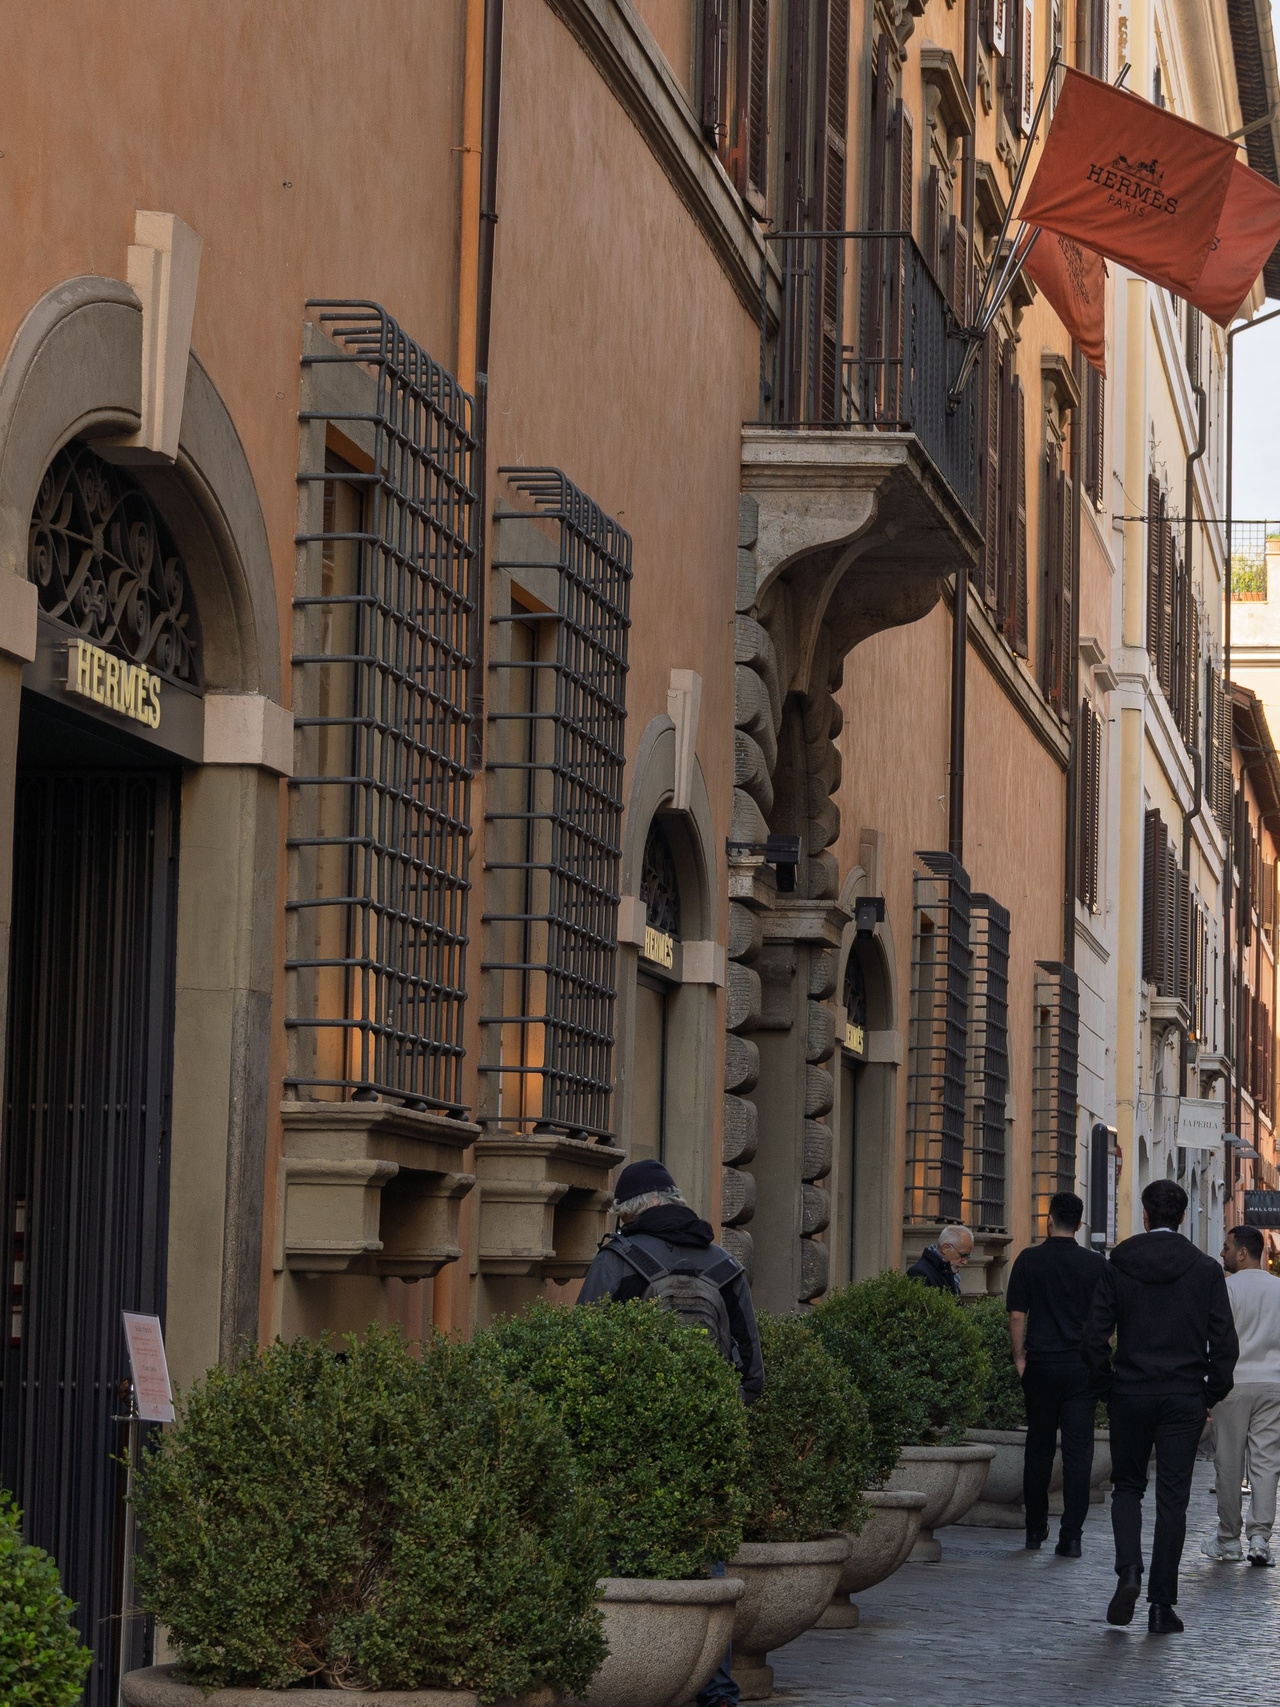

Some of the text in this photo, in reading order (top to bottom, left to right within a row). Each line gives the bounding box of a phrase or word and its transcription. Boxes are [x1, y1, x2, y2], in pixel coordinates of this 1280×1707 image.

[1086, 164, 1179, 215] HERMÈS
[1108, 194, 1146, 217] PARIS
[76, 638, 161, 729] HERMÈS
[644, 925, 674, 970] HERMÈS
[1183, 1119, 1218, 1129] LA PERLA
